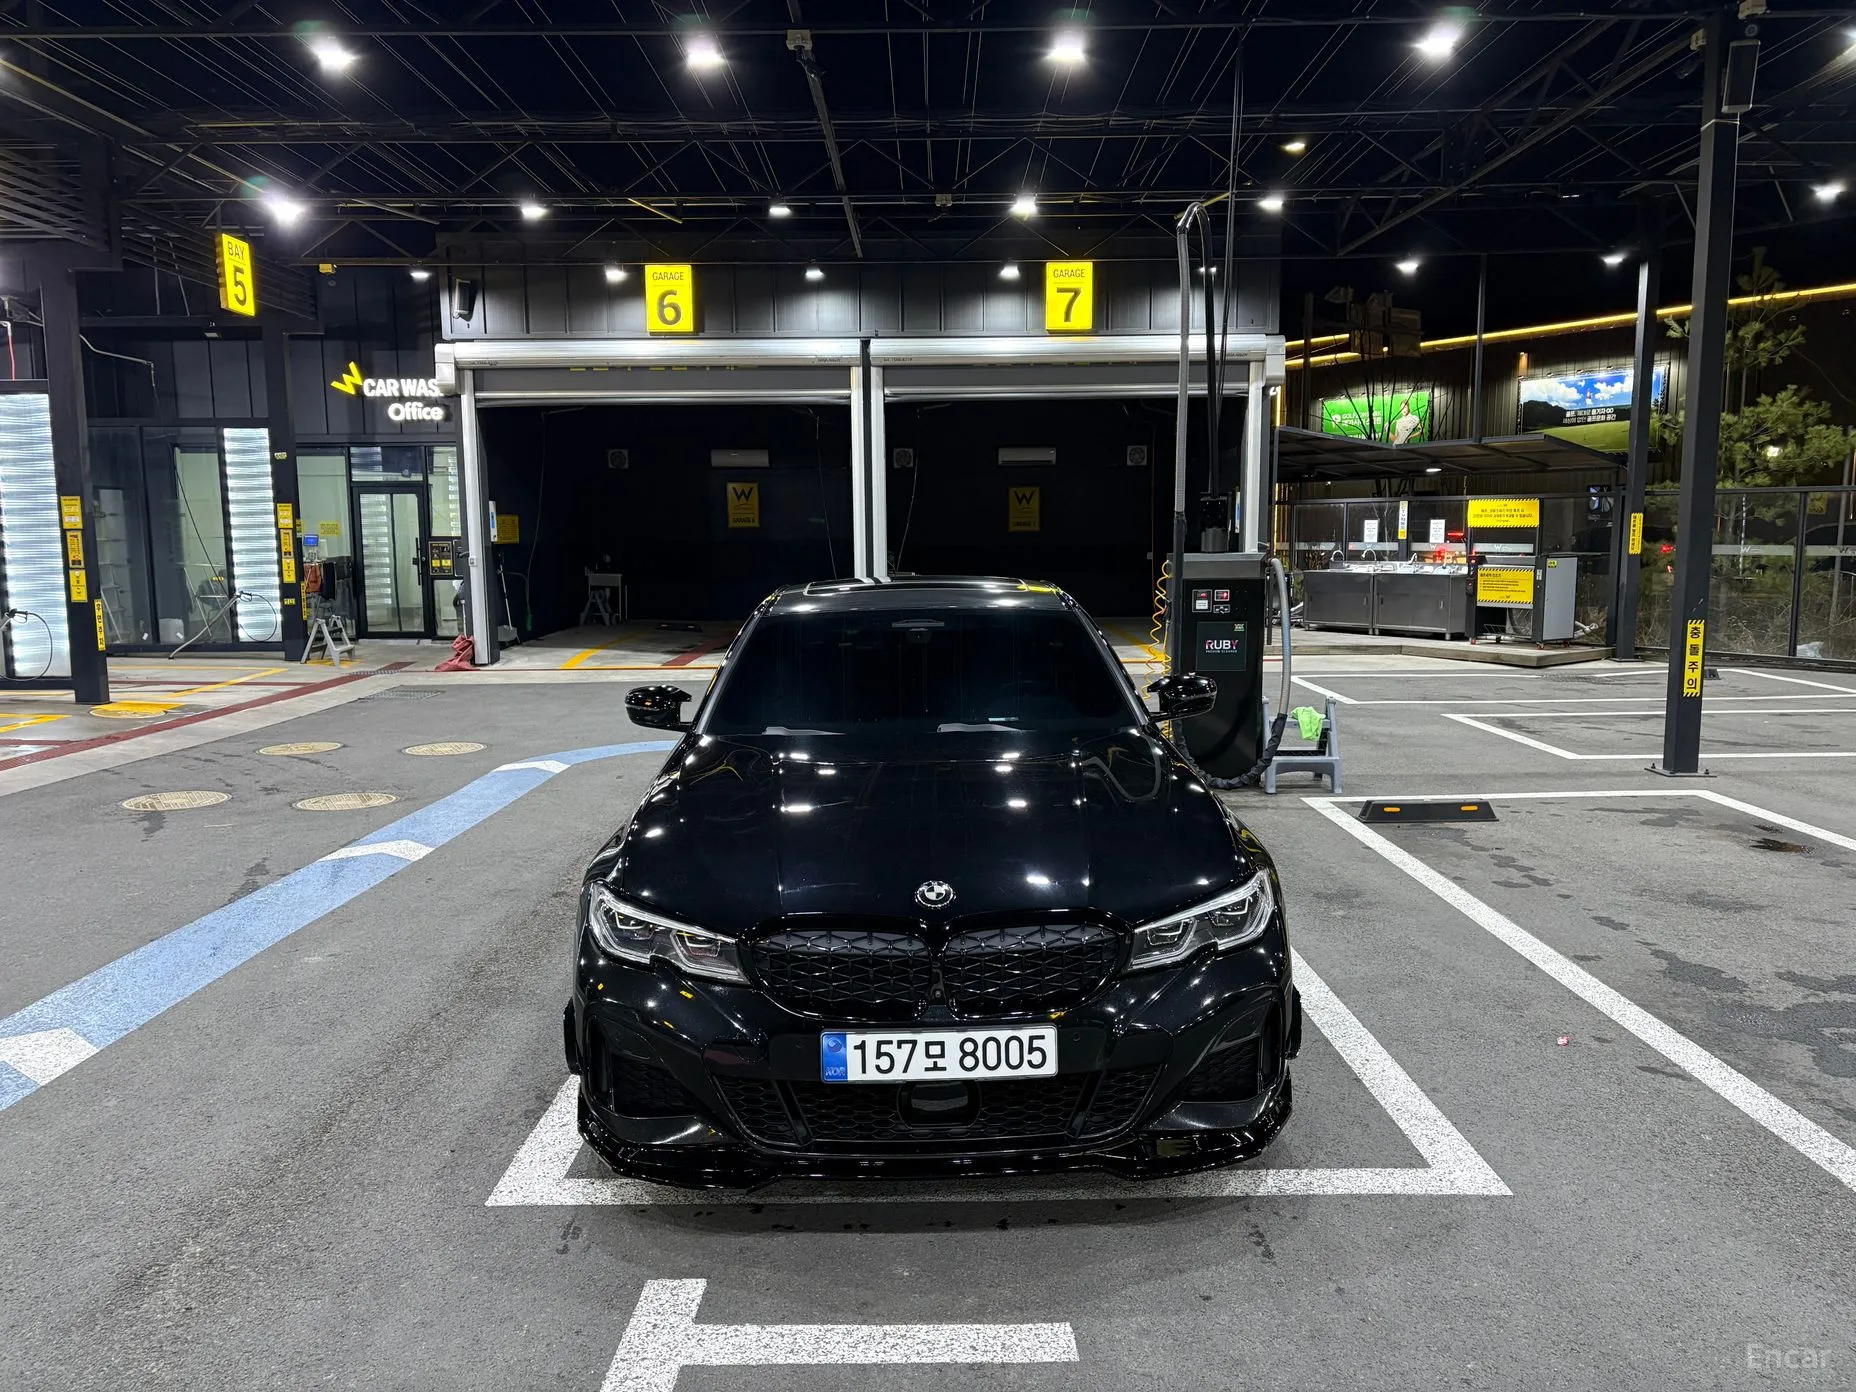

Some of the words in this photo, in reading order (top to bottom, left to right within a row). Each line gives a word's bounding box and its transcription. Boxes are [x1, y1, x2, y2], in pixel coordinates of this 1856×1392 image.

[228, 241, 245, 260] BAY
[652, 272, 684, 281] GARAGE
[1053, 269, 1085, 278] GARAGE
[233, 265, 247, 306] 5
[657, 289, 682, 326] 6
[1056, 287, 1082, 322] 7
[363, 378, 400, 397] CAR
[401, 378, 444, 397] WAS
[388, 401, 444, 420] Office
[1205, 640, 1239, 650] RUBY
[1686, 626, 1701, 690] 충돌주의
[853, 1039, 947, 1074] 157모
[959, 1034, 1047, 1072] 8005
